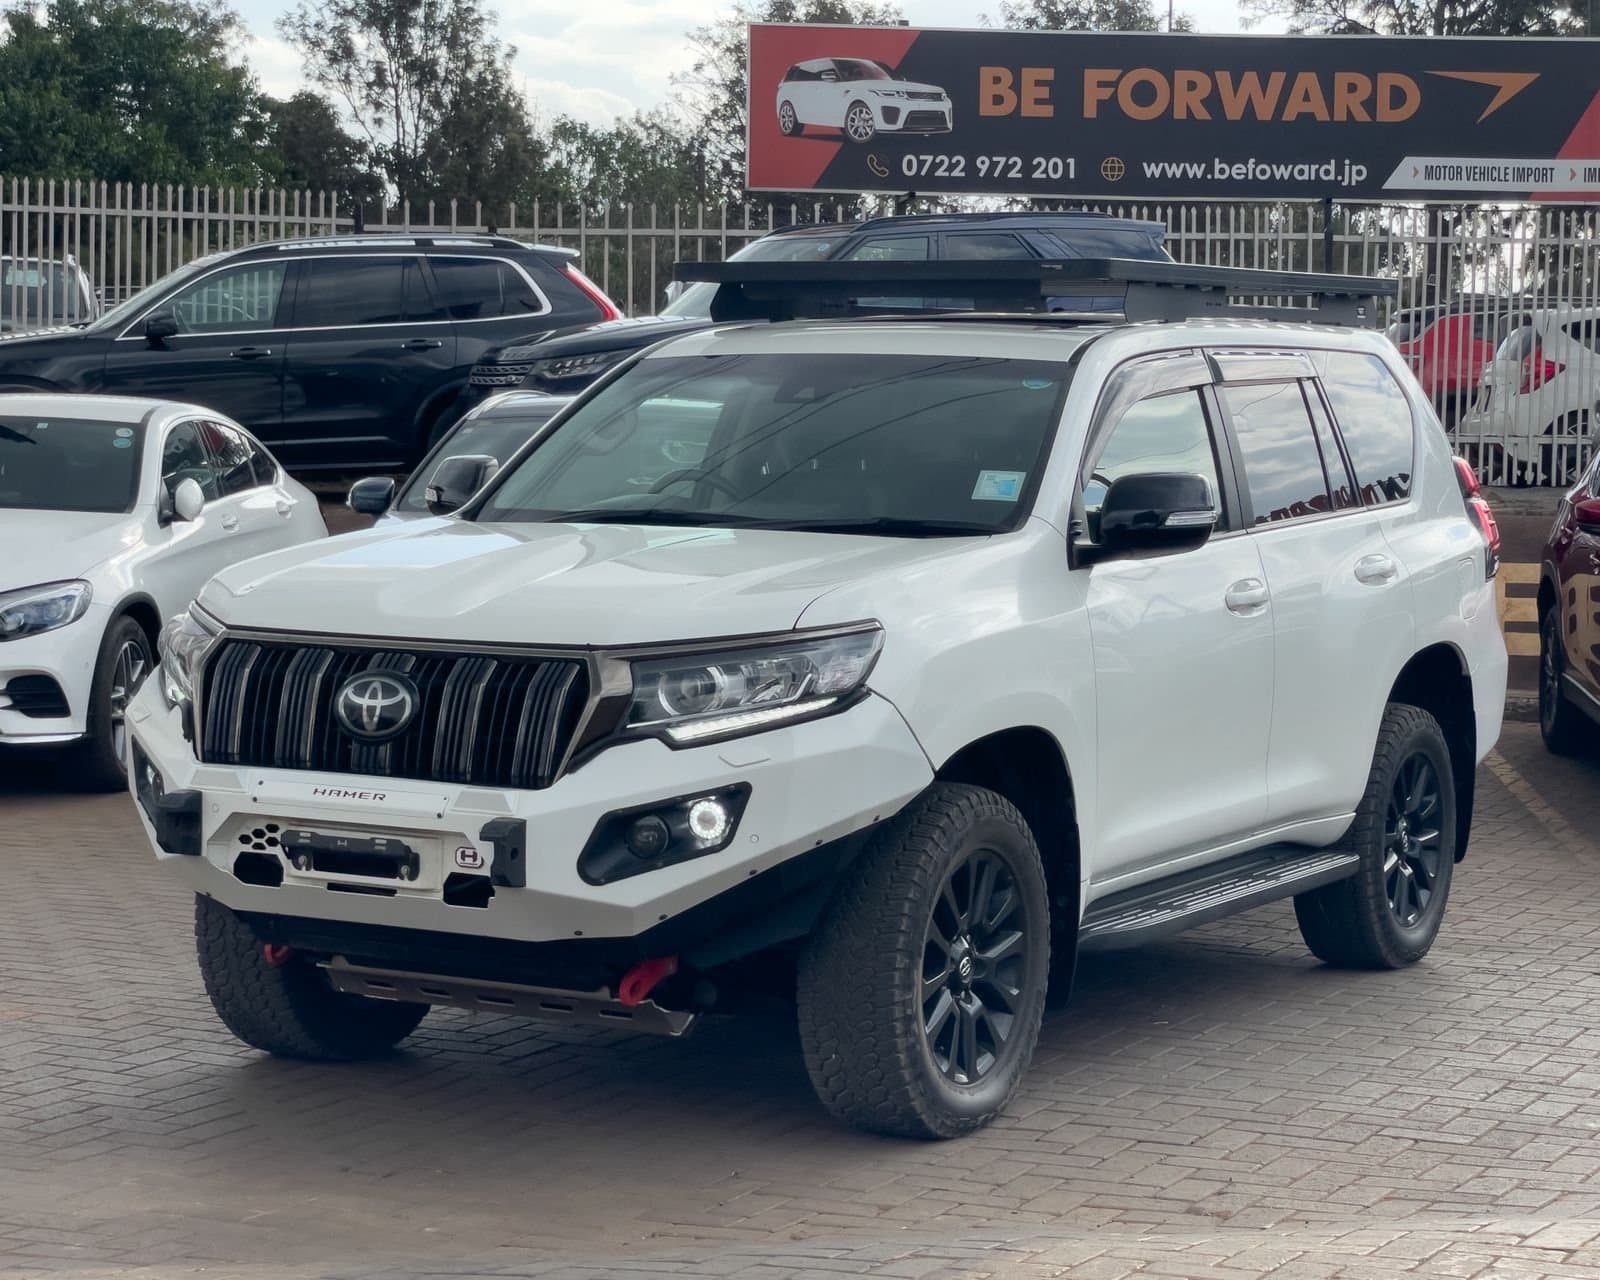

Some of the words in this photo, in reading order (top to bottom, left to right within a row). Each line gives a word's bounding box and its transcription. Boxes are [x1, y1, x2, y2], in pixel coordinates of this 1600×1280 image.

[979, 66, 1055, 118] BE
[1083, 68, 1421, 122] FORWARD
[901, 154, 966, 177] 0722
[976, 155, 1023, 178] 972
[1031, 156, 1076, 179] 201
[1142, 157, 1368, 186] www.befoward.jp
[1424, 165, 1463, 182] MOTOR
[1465, 165, 1510, 183] VEHICLE
[1512, 166, 1555, 183] IMPORT
[1583, 167, 1600, 183] IM
[312, 787, 386, 801] HAMER
